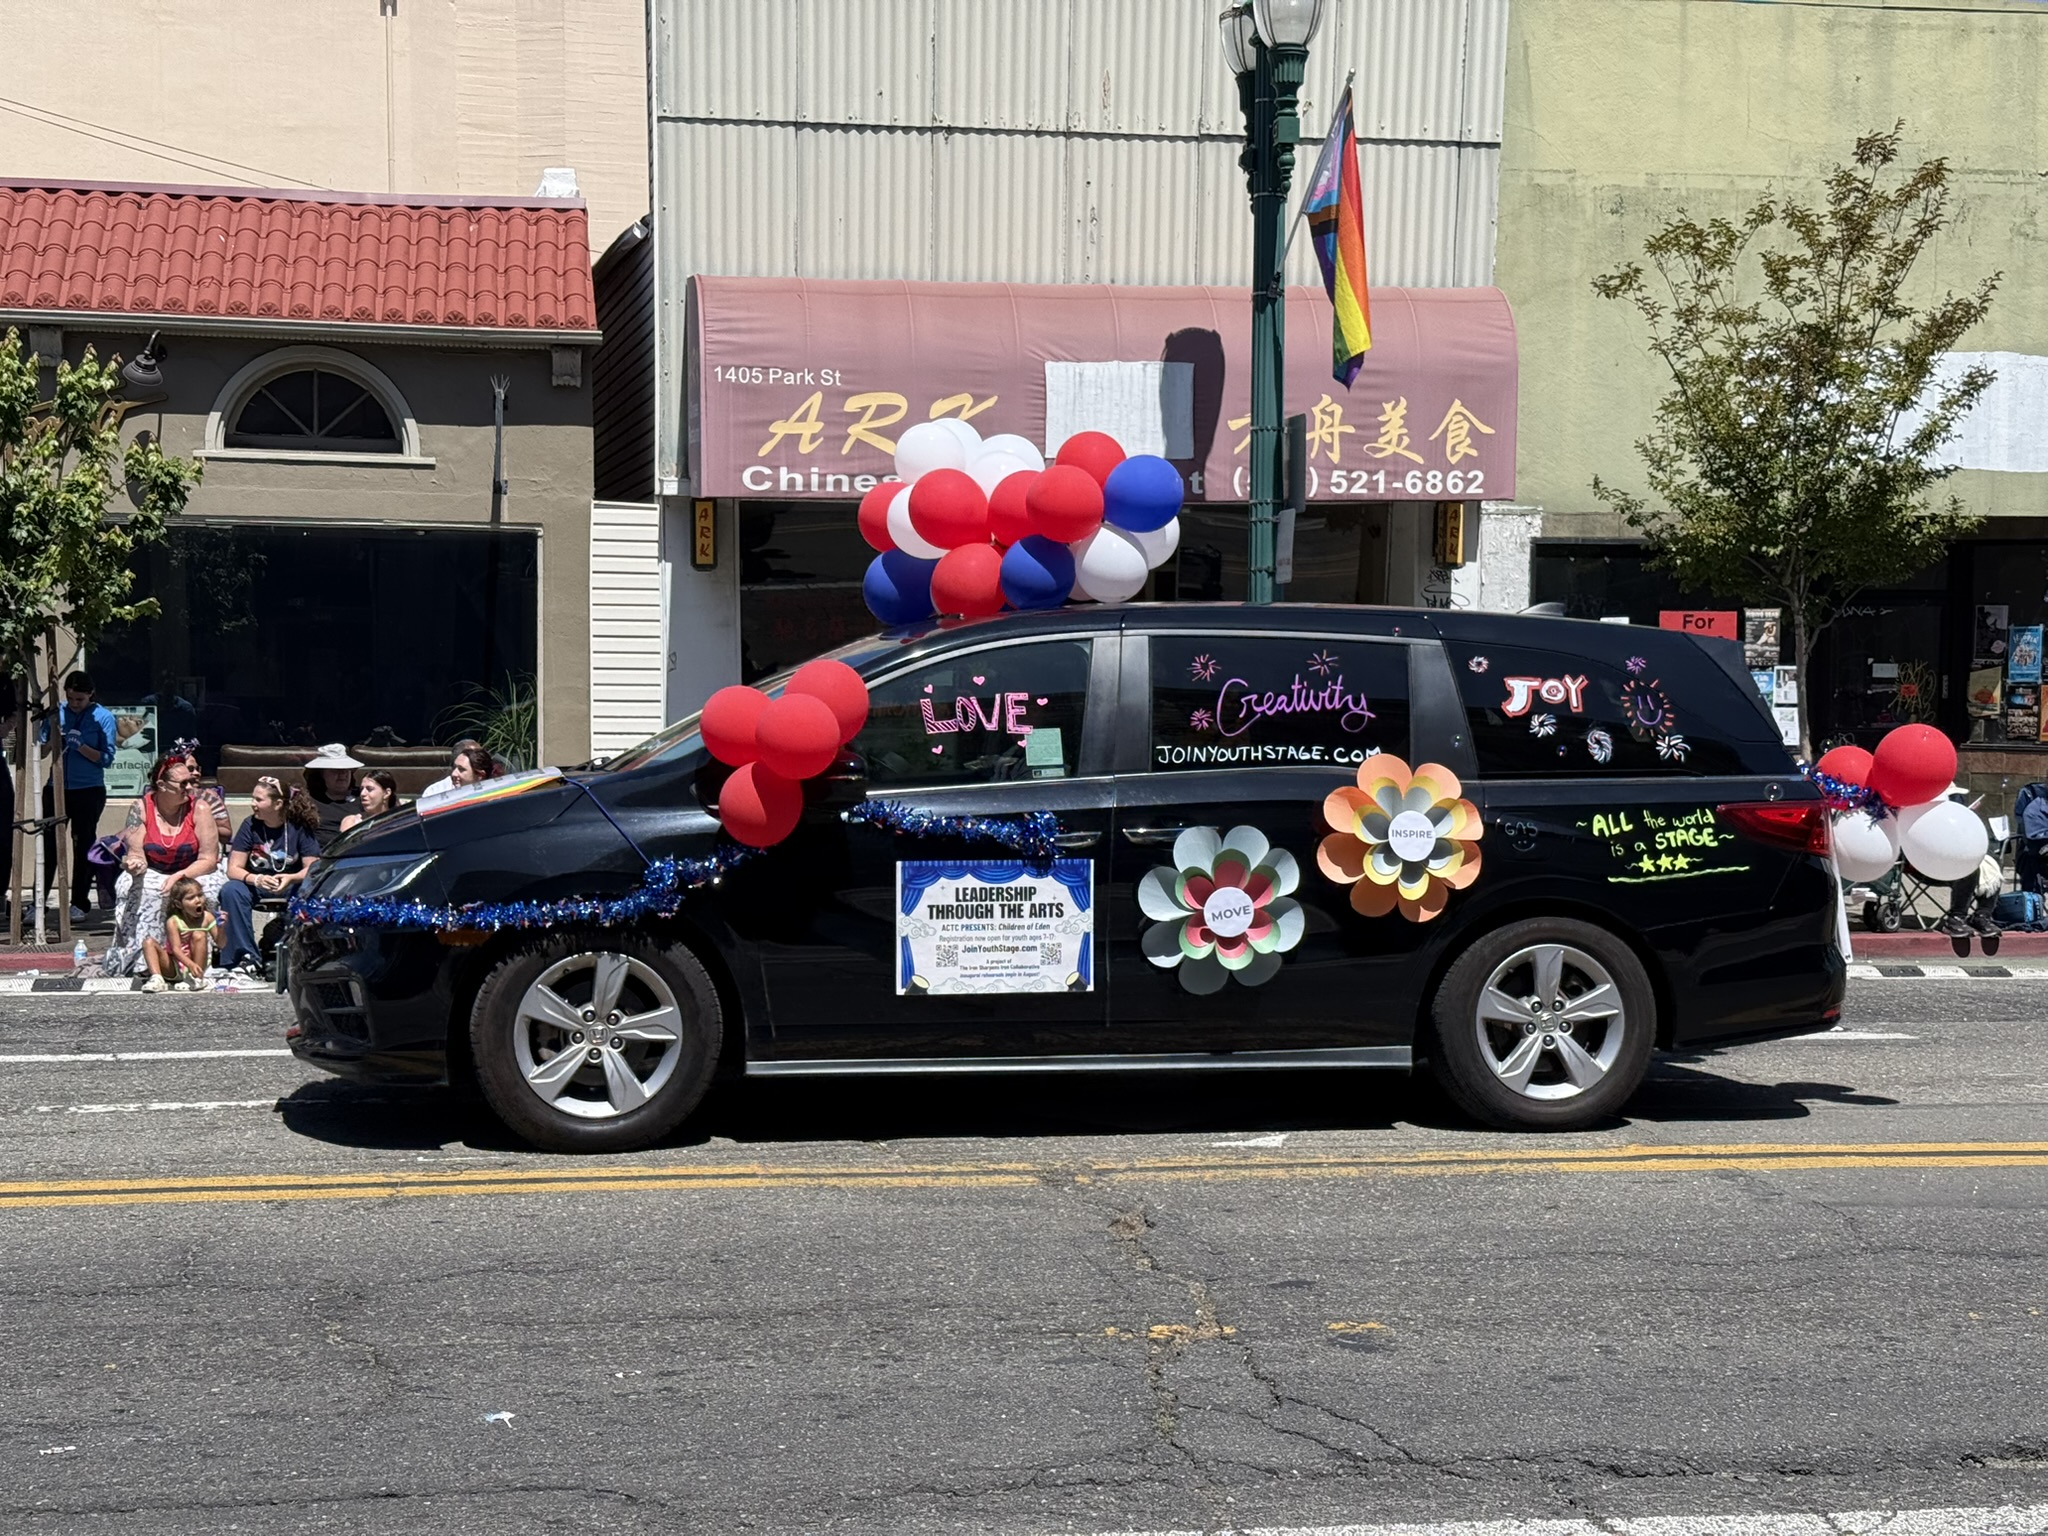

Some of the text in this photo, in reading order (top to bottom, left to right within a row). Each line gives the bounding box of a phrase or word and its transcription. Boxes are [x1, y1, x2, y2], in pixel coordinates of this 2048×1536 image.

[714, 366, 842, 386] 1405 Park St
[741, 465, 903, 493] Chine
[1330, 469, 1485, 495] 521-6862
[698, 507, 712, 558] ARK
[1682, 613, 1716, 631] For
[1216, 673, 1377, 737] Creativity
[1501, 674, 1589, 718] JOY
[920, 692, 1034, 735] LOVE
[1155, 745, 1382, 764] JOINYOUTHSTAGE.COM
[1504, 821, 1540, 836] GAS
[1592, 808, 1715, 838] ALL the world
[1391, 828, 1433, 840] INSPIRE
[1610, 827, 1719, 857] is a STAGE
[955, 886, 1037, 902] LEADERSHIP
[927, 902, 1064, 920] THROUGH THE ARTS
[1211, 904, 1252, 922] MOVE
[941, 922, 1051, 932] ACTC PRESENTS: Children of Eden
[939, 935, 974, 943] Registration
[1011, 934, 1028, 942] youth
[961, 943, 1038, 954] JoinYouthStage.com
